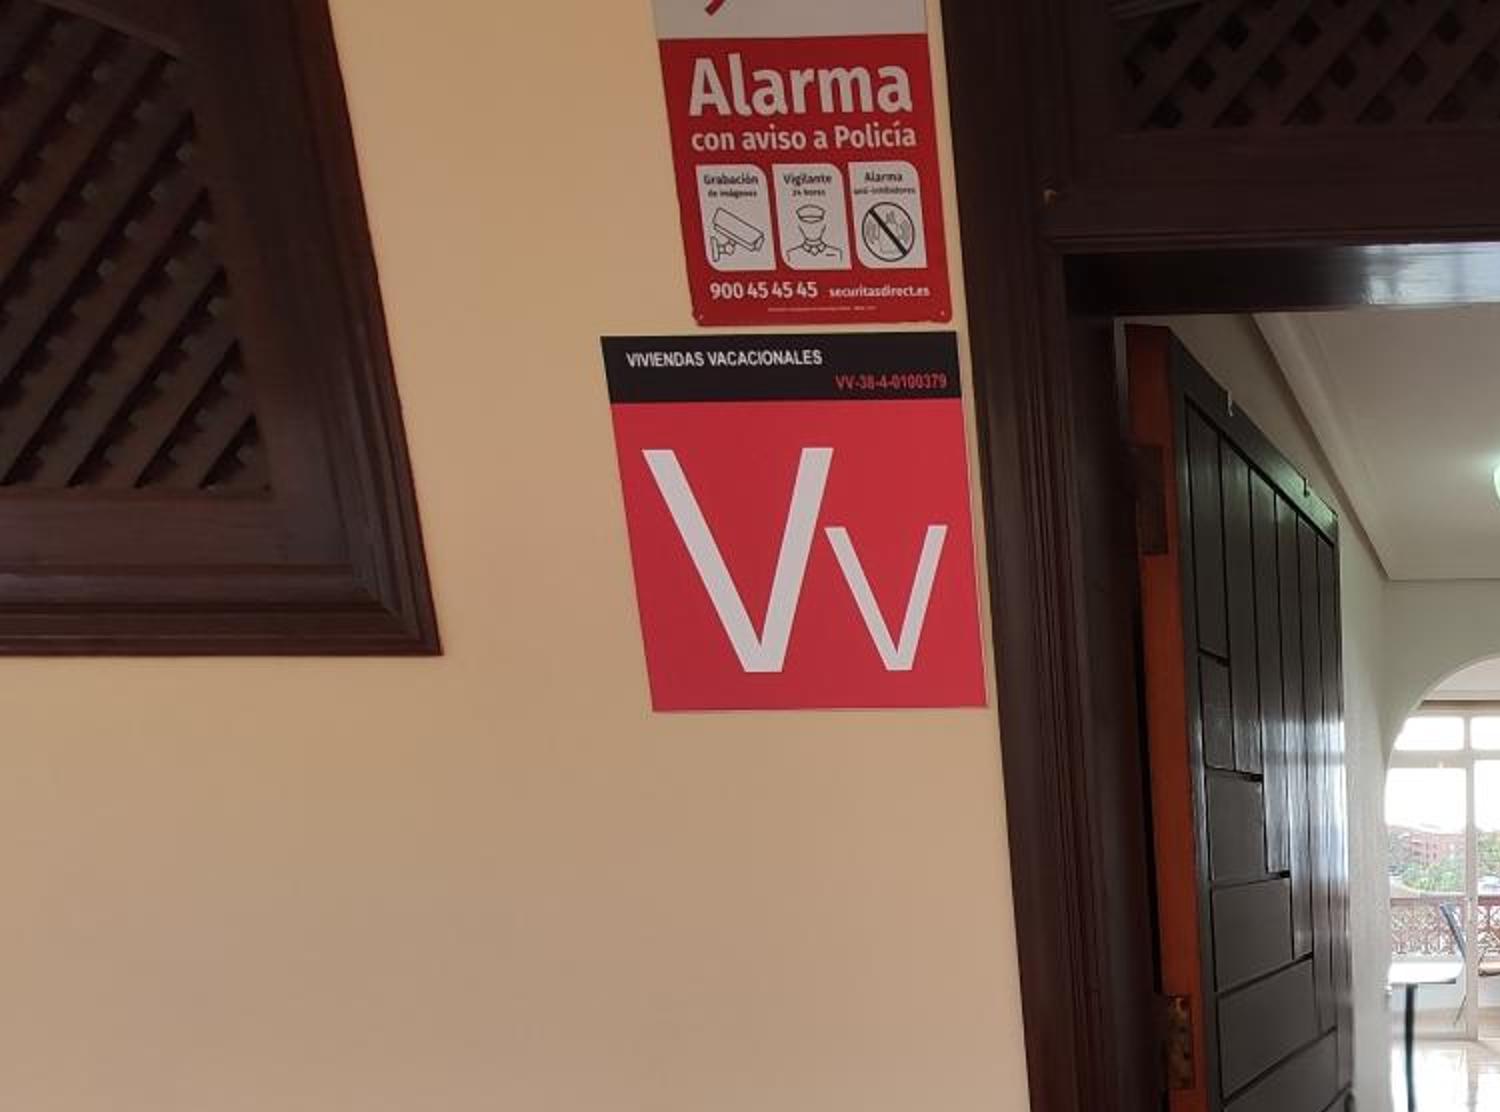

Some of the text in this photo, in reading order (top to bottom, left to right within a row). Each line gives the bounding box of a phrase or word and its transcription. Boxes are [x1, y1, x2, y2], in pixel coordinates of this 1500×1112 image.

[689, 53, 913, 117] Alarma
[691, 121, 918, 151] con aviso a Policía
[703, 172, 759, 185] Grabación
[783, 172, 832, 186] Vigilante
[864, 172, 903, 183] Alarma
[710, 281, 818, 299] 900 45 45 45
[829, 284, 931, 298] securitasdirect.es
[626, 350, 823, 368] VIVIENDAS VACACIONALES
[835, 374, 948, 391] VV-38-4-0100379
